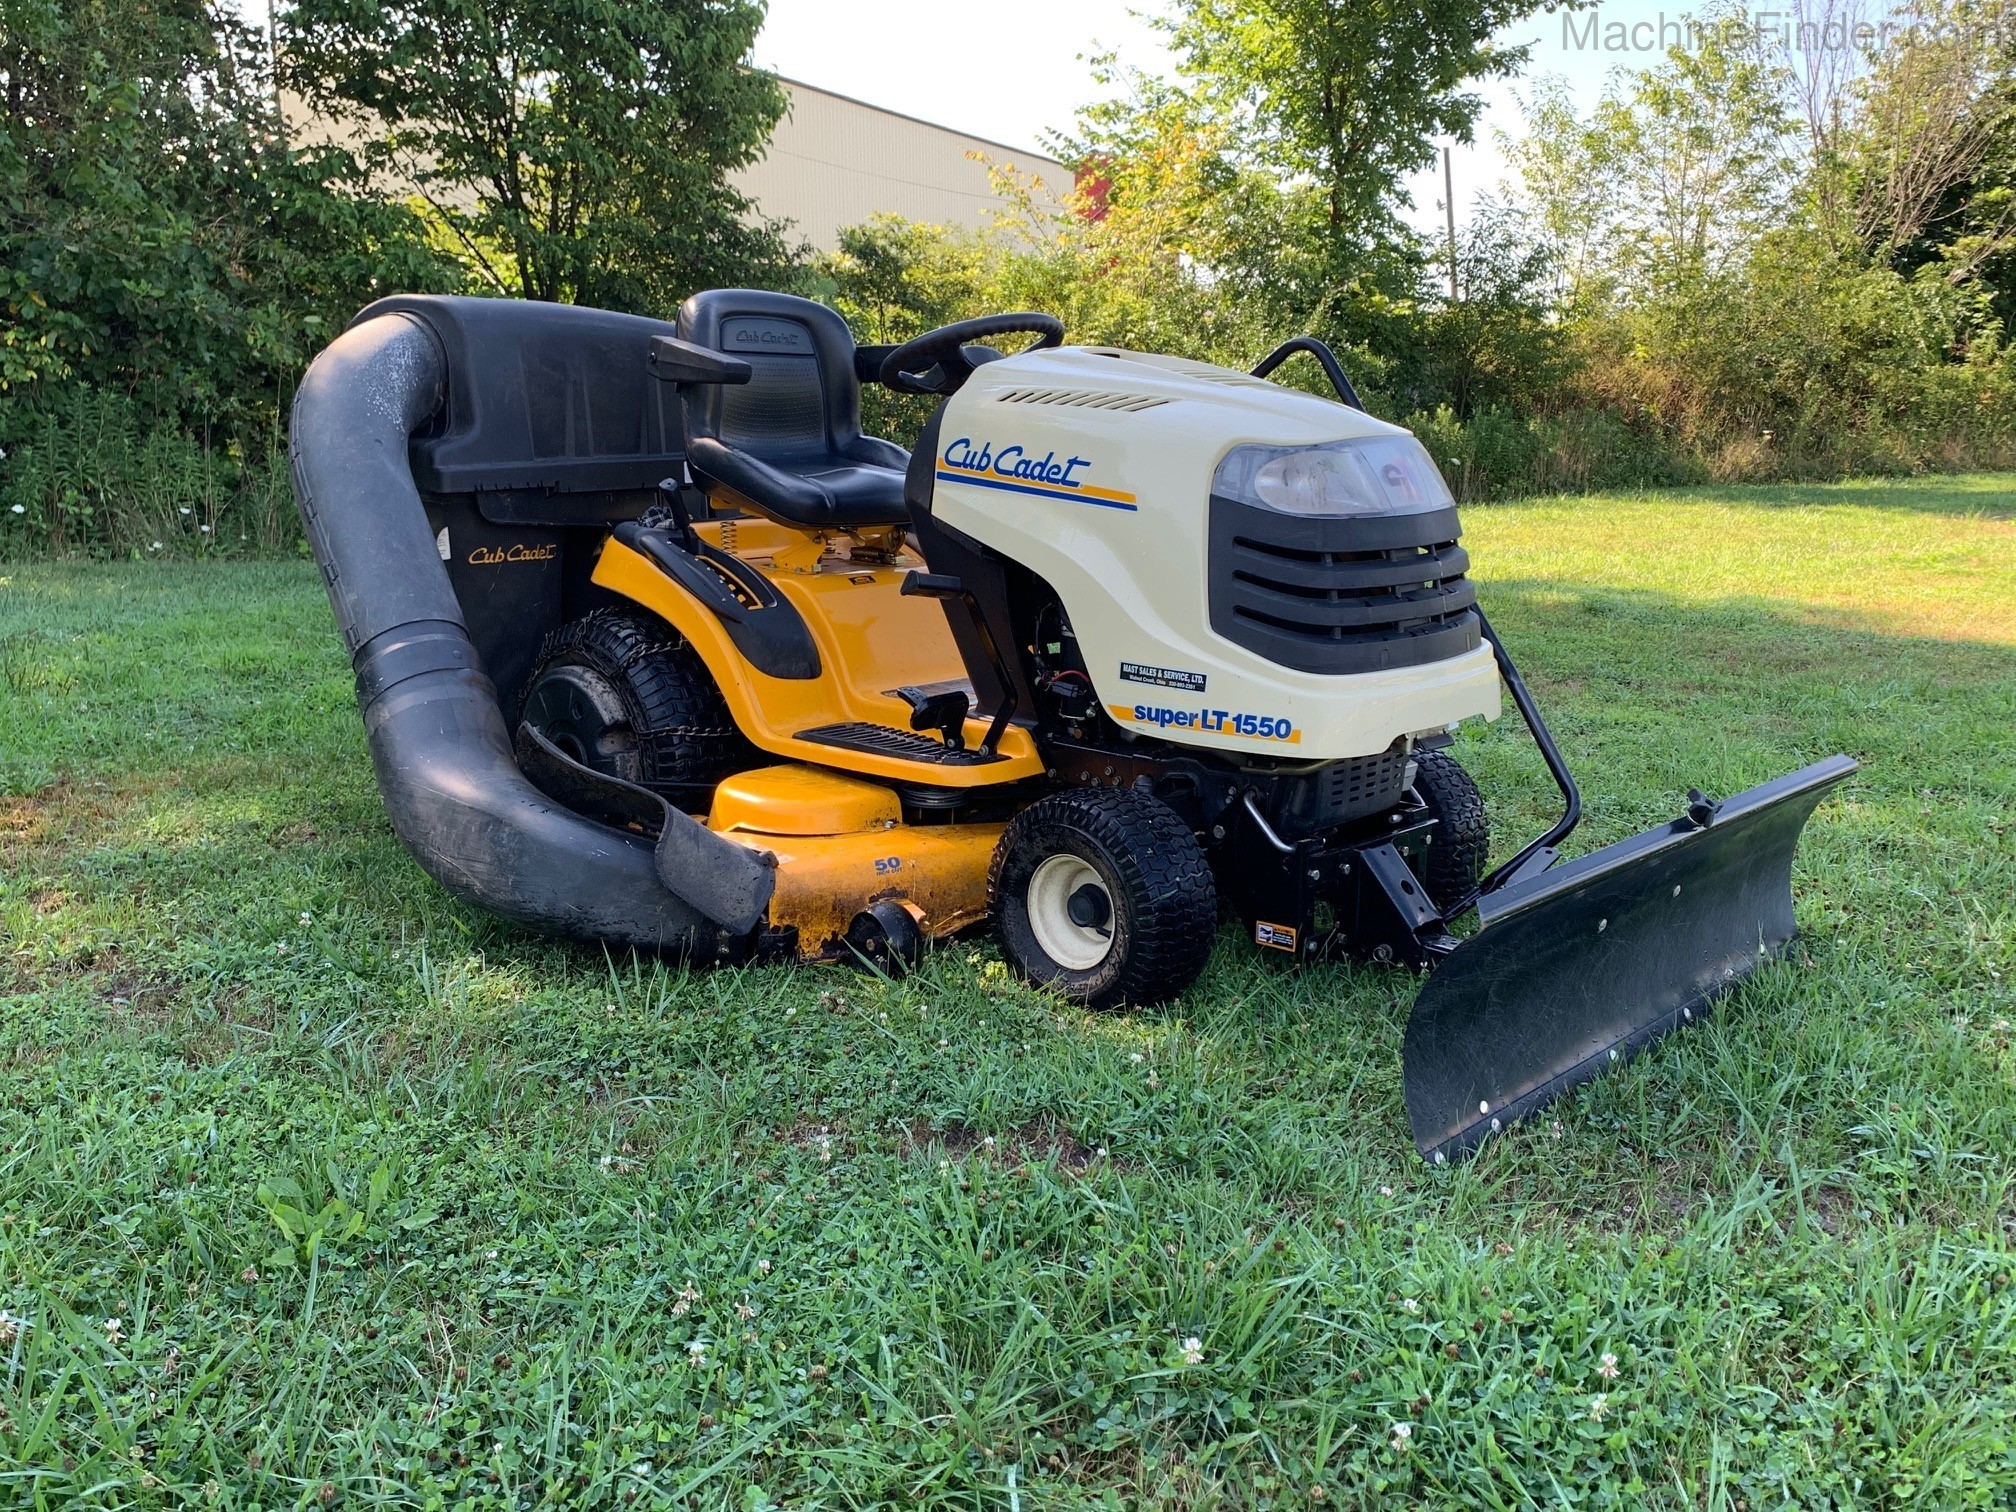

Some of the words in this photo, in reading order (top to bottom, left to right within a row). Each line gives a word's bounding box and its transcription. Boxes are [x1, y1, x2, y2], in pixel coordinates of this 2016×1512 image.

[736, 330, 759, 343] Cub
[761, 331, 798, 345] Cadet
[944, 437, 992, 472] Cub
[993, 445, 1092, 488] Cadet
[468, 546, 505, 564] Cub
[506, 543, 556, 561] Cadet
[1122, 663, 1138, 674] MAST
[1138, 666, 1157, 677] SALES
[1157, 669, 1163, 678] &
[1163, 670, 1190, 683] SERVICE,
[1191, 674, 1204, 684] LTD.
[1134, 704, 1198, 728] super
[1201, 708, 1229, 731] LT
[1232, 713, 1292, 739] 1550
[874, 857, 901, 872] 50
